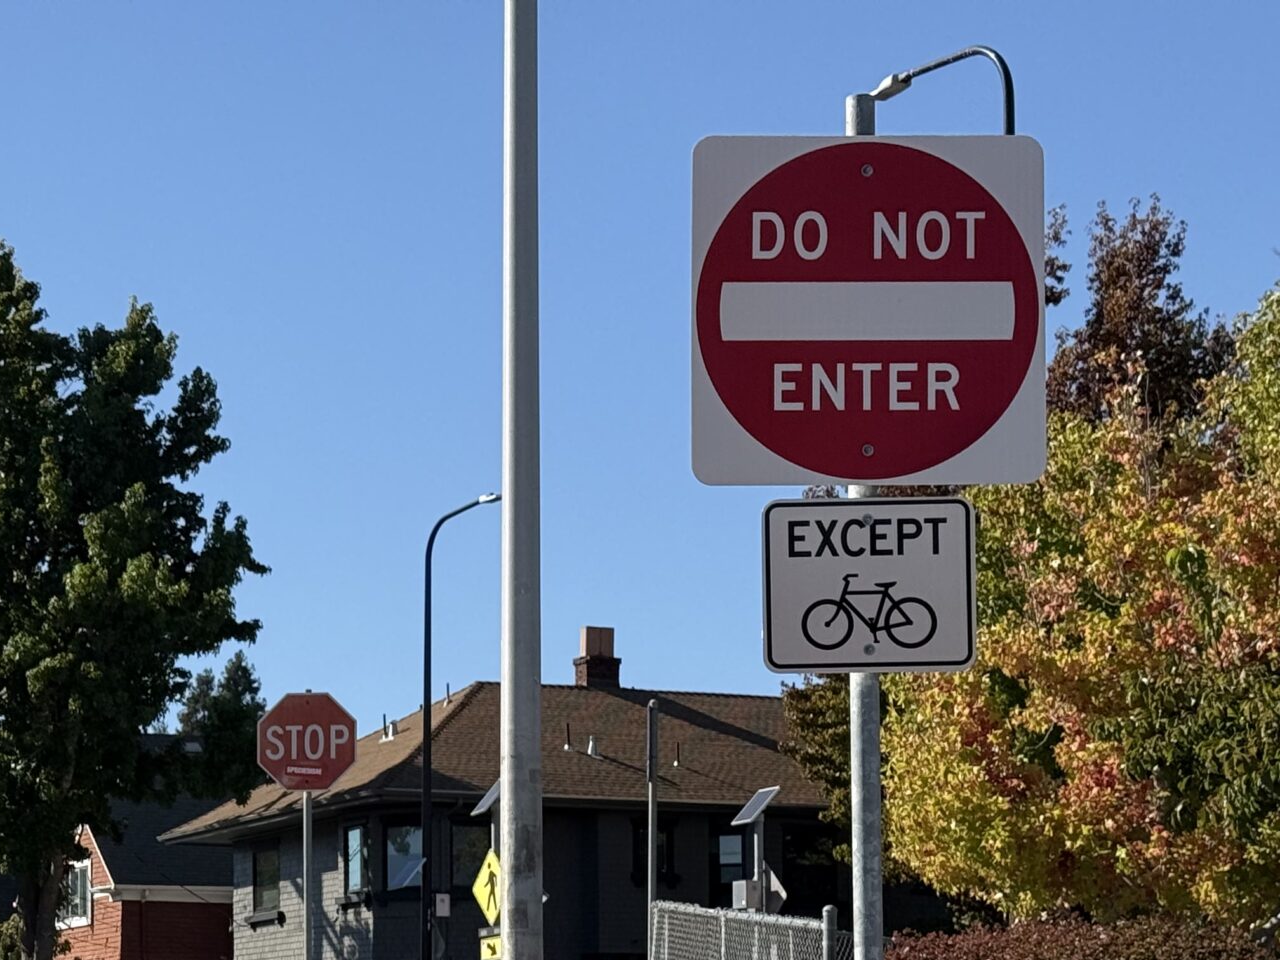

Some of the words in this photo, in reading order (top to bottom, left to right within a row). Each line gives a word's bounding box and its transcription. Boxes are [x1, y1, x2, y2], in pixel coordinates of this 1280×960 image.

[751, 210, 829, 261] DO
[873, 210, 986, 261] NOT
[773, 362, 961, 412] ENTER
[787, 517, 948, 558] EXCEPT
[265, 723, 350, 761] STOP
